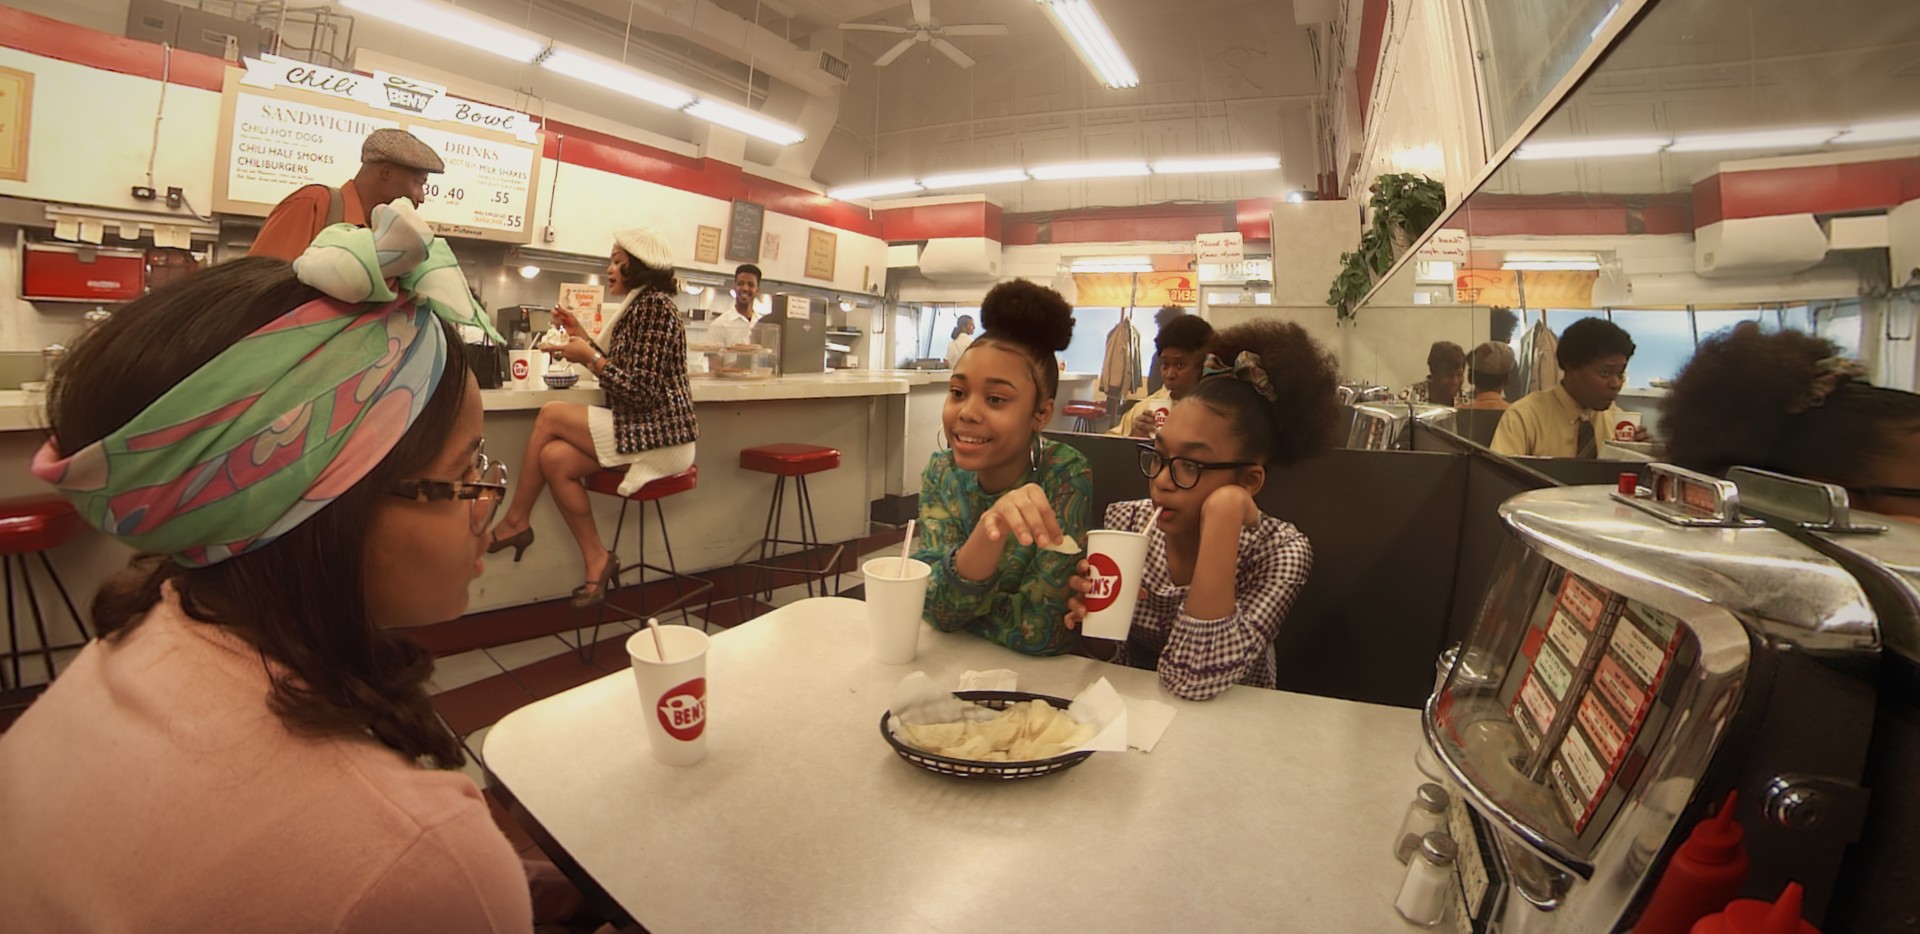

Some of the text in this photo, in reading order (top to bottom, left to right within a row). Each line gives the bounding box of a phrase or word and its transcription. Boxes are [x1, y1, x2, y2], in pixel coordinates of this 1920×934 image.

[286, 67, 358, 96] Chili
[390, 88, 428, 111] BEN'S
[455, 103, 515, 130] Bowl
[241, 122, 268, 135] CHILI
[270, 127, 292, 138] HOT
[296, 130, 323, 144] DOGS
[239, 142, 334, 165] CHILI HALF SMOKES
[445, 140, 499, 161] DRINKS
[238, 156, 308, 174] CHILIBURGERS
[499, 167, 527, 180] SHAKES
[444, 187, 464, 201] .40
[491, 191, 509, 204] .55
[503, 215, 521, 228] .55
[1198, 239, 1220, 248] Thank
[1199, 250, 1241, 260] Come Again
